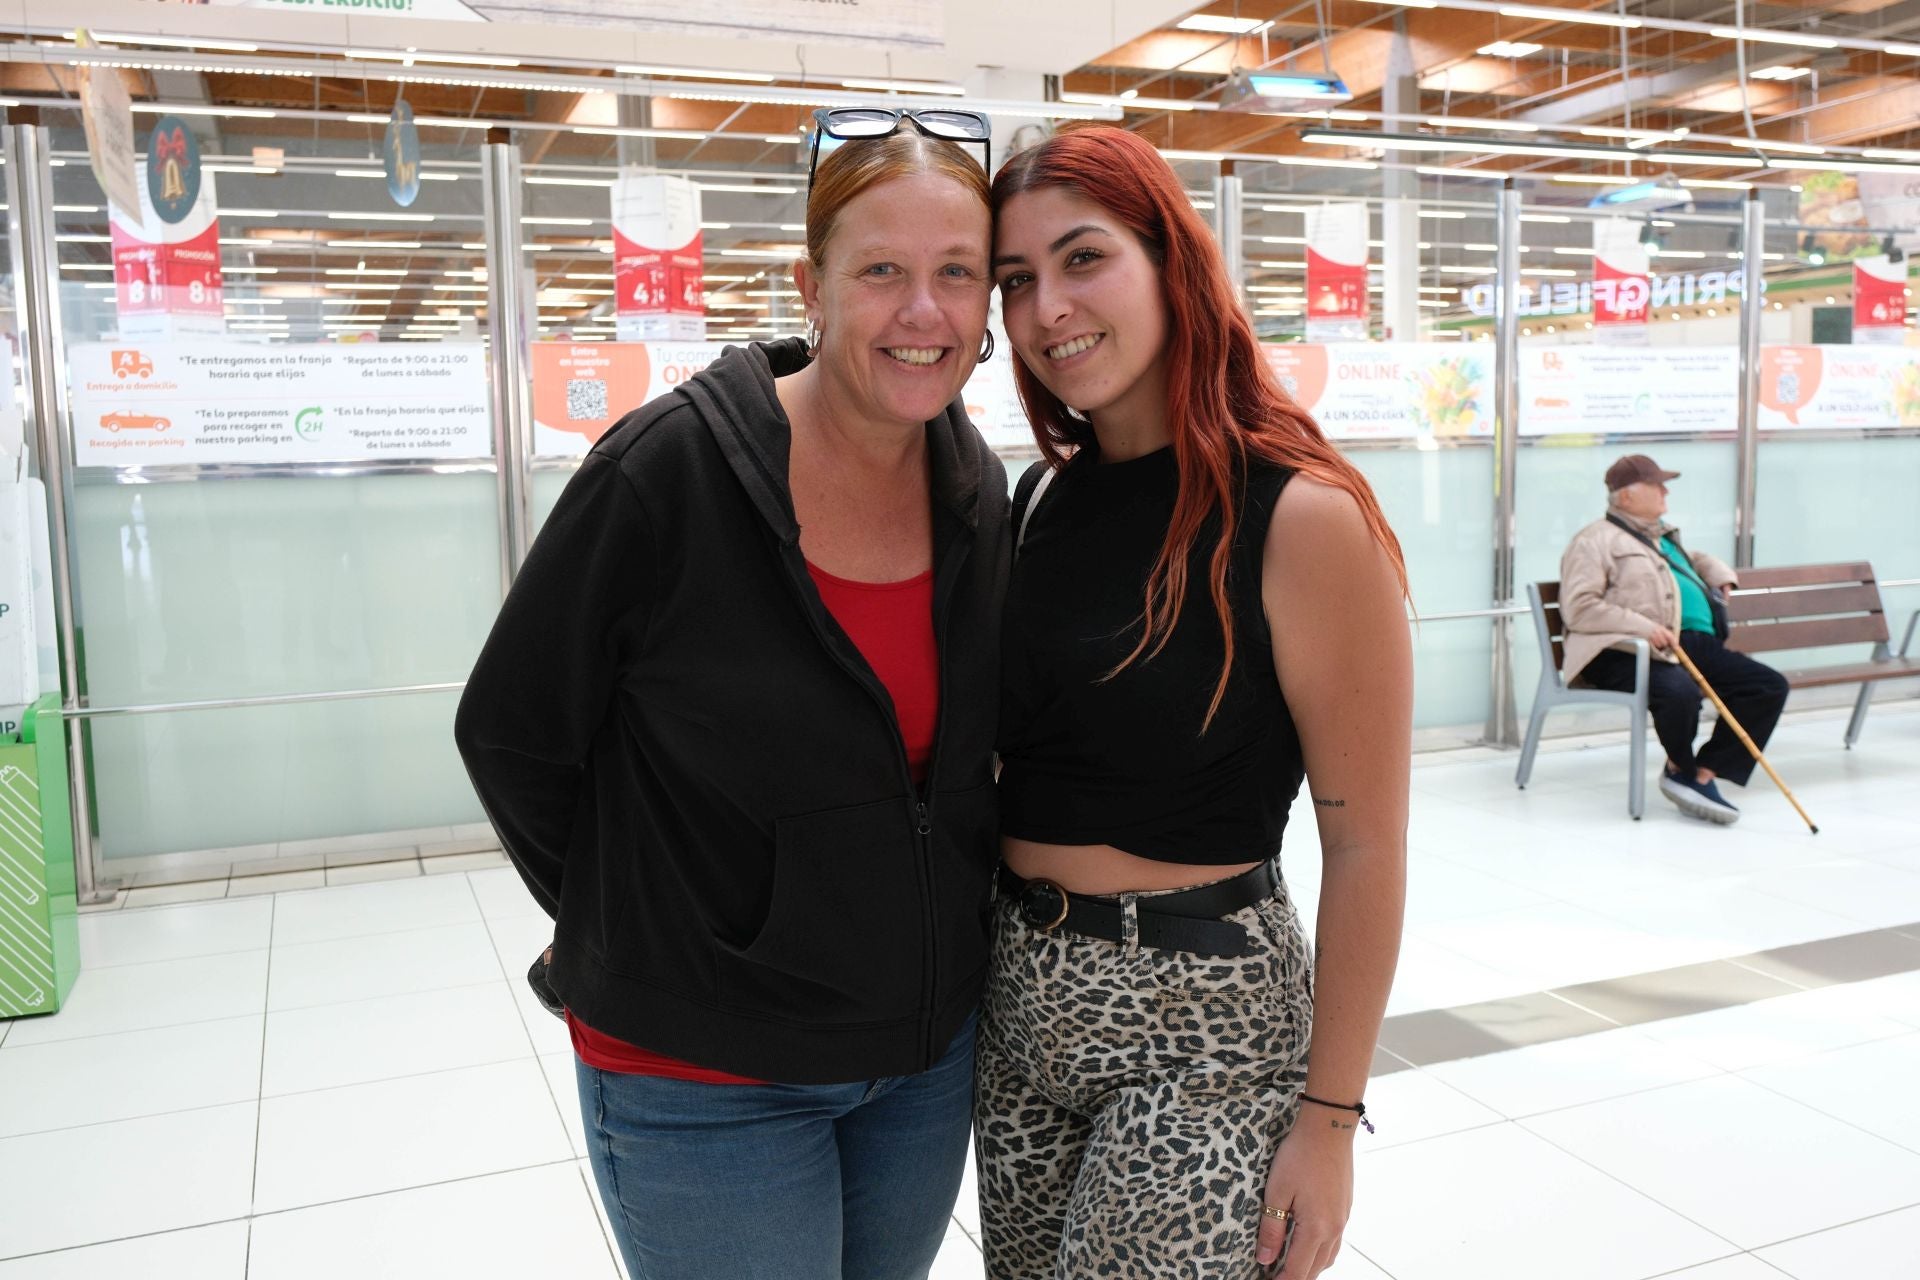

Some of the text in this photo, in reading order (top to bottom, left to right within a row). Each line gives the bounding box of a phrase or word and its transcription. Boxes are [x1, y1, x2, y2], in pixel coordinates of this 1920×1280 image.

[189, 280, 205, 304] 8
[633, 283, 650, 305] 4
[200, 356, 267, 368] entregamos
[285, 355, 296, 363] la
[299, 354, 332, 365] franja
[391, 355, 403, 364] de
[406, 355, 429, 363] 9:00
[440, 355, 468, 363] 21:00
[656, 348, 673, 363] Tu
[559, 359, 573, 367] en
[209, 369, 306, 380] horaria que elijas
[362, 368, 374, 377] de
[375, 368, 404, 377] lunes
[415, 368, 452, 377] sábado
[575, 368, 596, 377] web
[1337, 364, 1401, 380] ONLINE
[1830, 364, 1879, 378] ONLINE
[87, 382, 125, 392] Entrega
[133, 381, 178, 390] domicilio
[227, 409, 289, 420] preparamos
[353, 406, 364, 415] la
[366, 406, 398, 417] franja
[399, 405, 436, 415] horaria
[437, 406, 456, 416] que
[458, 405, 485, 415] elijas
[1324, 410, 1335, 421] A
[1352, 410, 1380, 421] SOLO
[203, 422, 283, 432] para recoger en
[304, 421, 324, 432] 2H
[394, 427, 406, 436] de
[440, 426, 468, 434] 21:00
[89, 438, 133, 448] Recogida
[148, 437, 186, 448] parking
[195, 435, 236, 444] nuestro
[238, 433, 279, 444] parking
[366, 440, 378, 449] de
[379, 439, 406, 448] lunes
[416, 438, 452, 448] sábado
